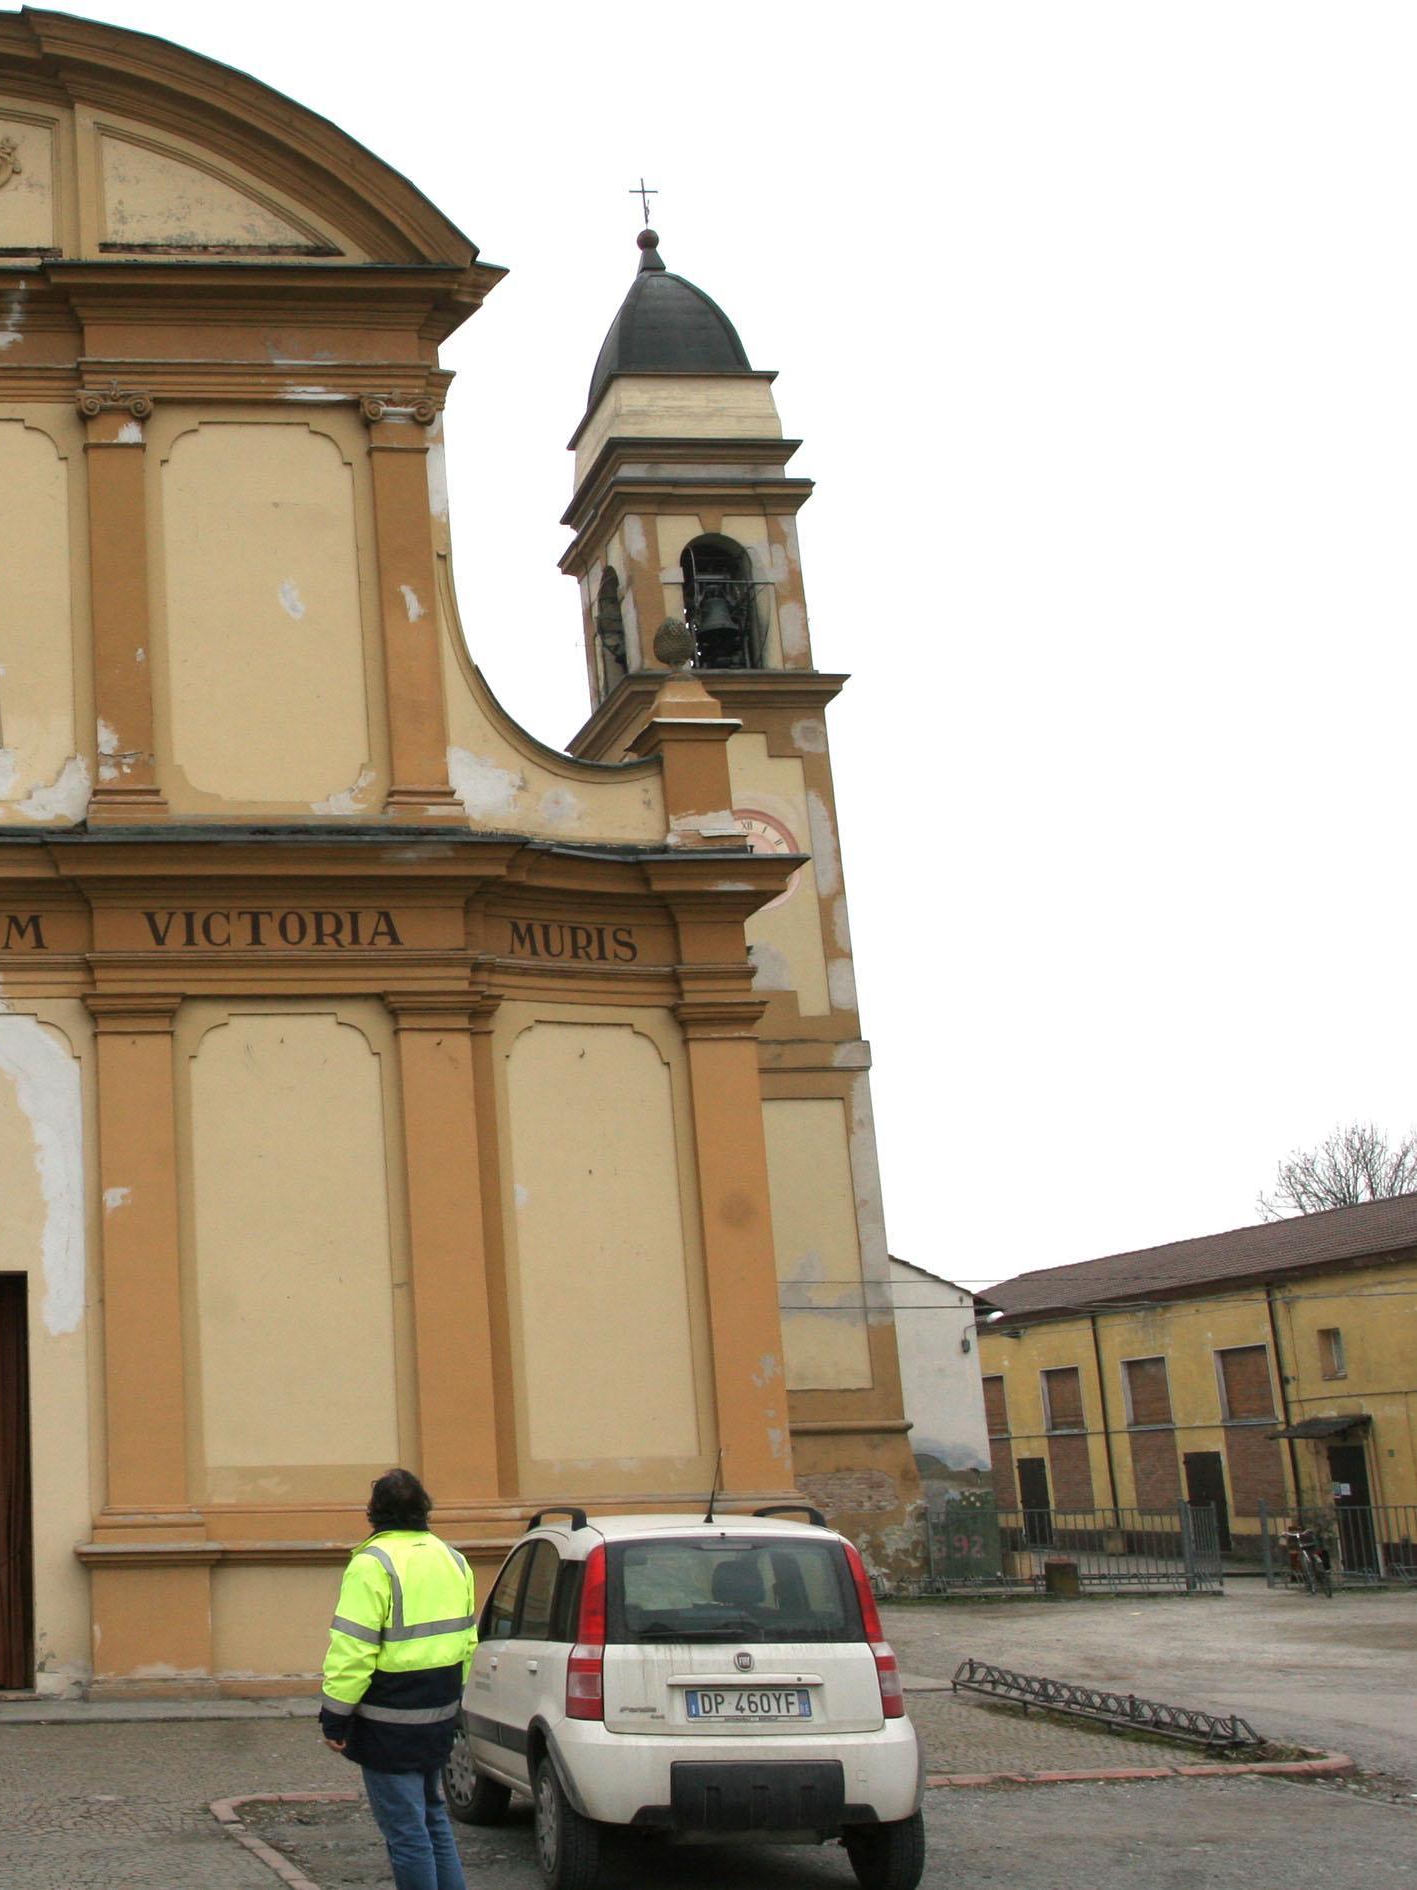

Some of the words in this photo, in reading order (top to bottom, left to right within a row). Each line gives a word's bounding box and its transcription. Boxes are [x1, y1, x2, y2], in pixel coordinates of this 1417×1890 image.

[141, 909, 405, 947] VICTORIA
[509, 919, 639, 963] MURIS
[700, 1692, 725, 1714] DP
[735, 1692, 796, 1714] 460YF
